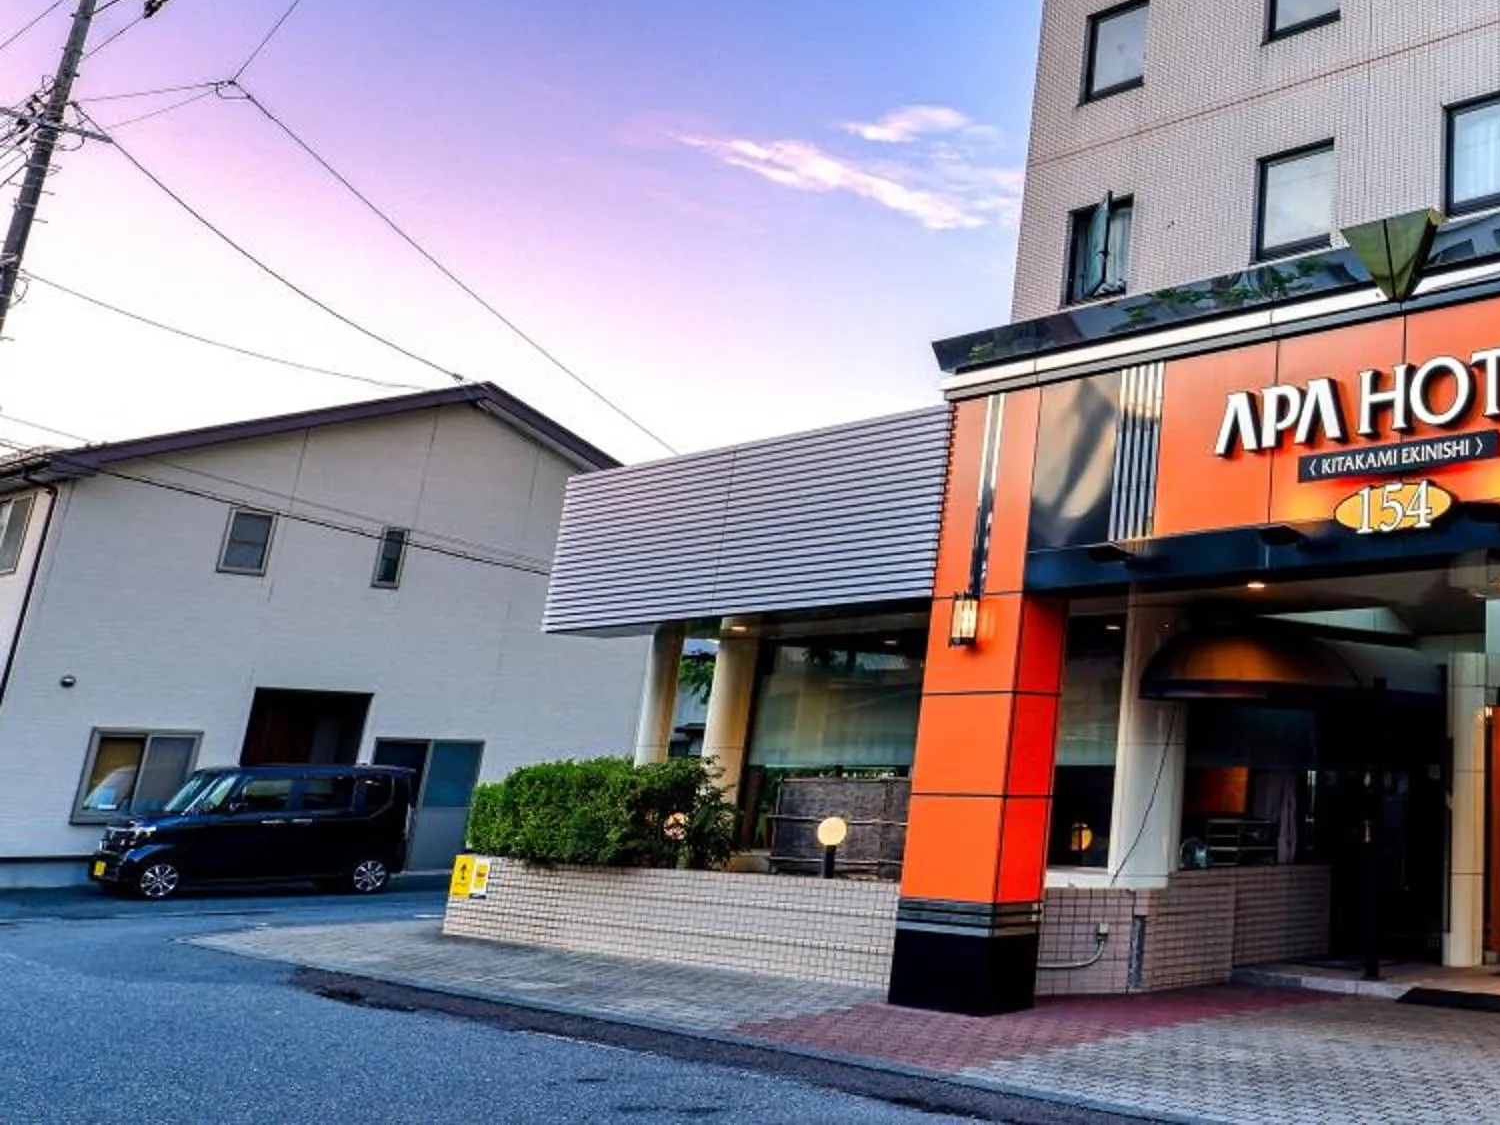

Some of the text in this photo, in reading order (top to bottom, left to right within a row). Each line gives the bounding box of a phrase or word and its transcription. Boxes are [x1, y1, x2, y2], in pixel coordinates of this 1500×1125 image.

[1214, 377, 1344, 455] APA
[1321, 438, 1470, 475] KITAKAMI EKINISHI
[1356, 479, 1433, 534] 154
